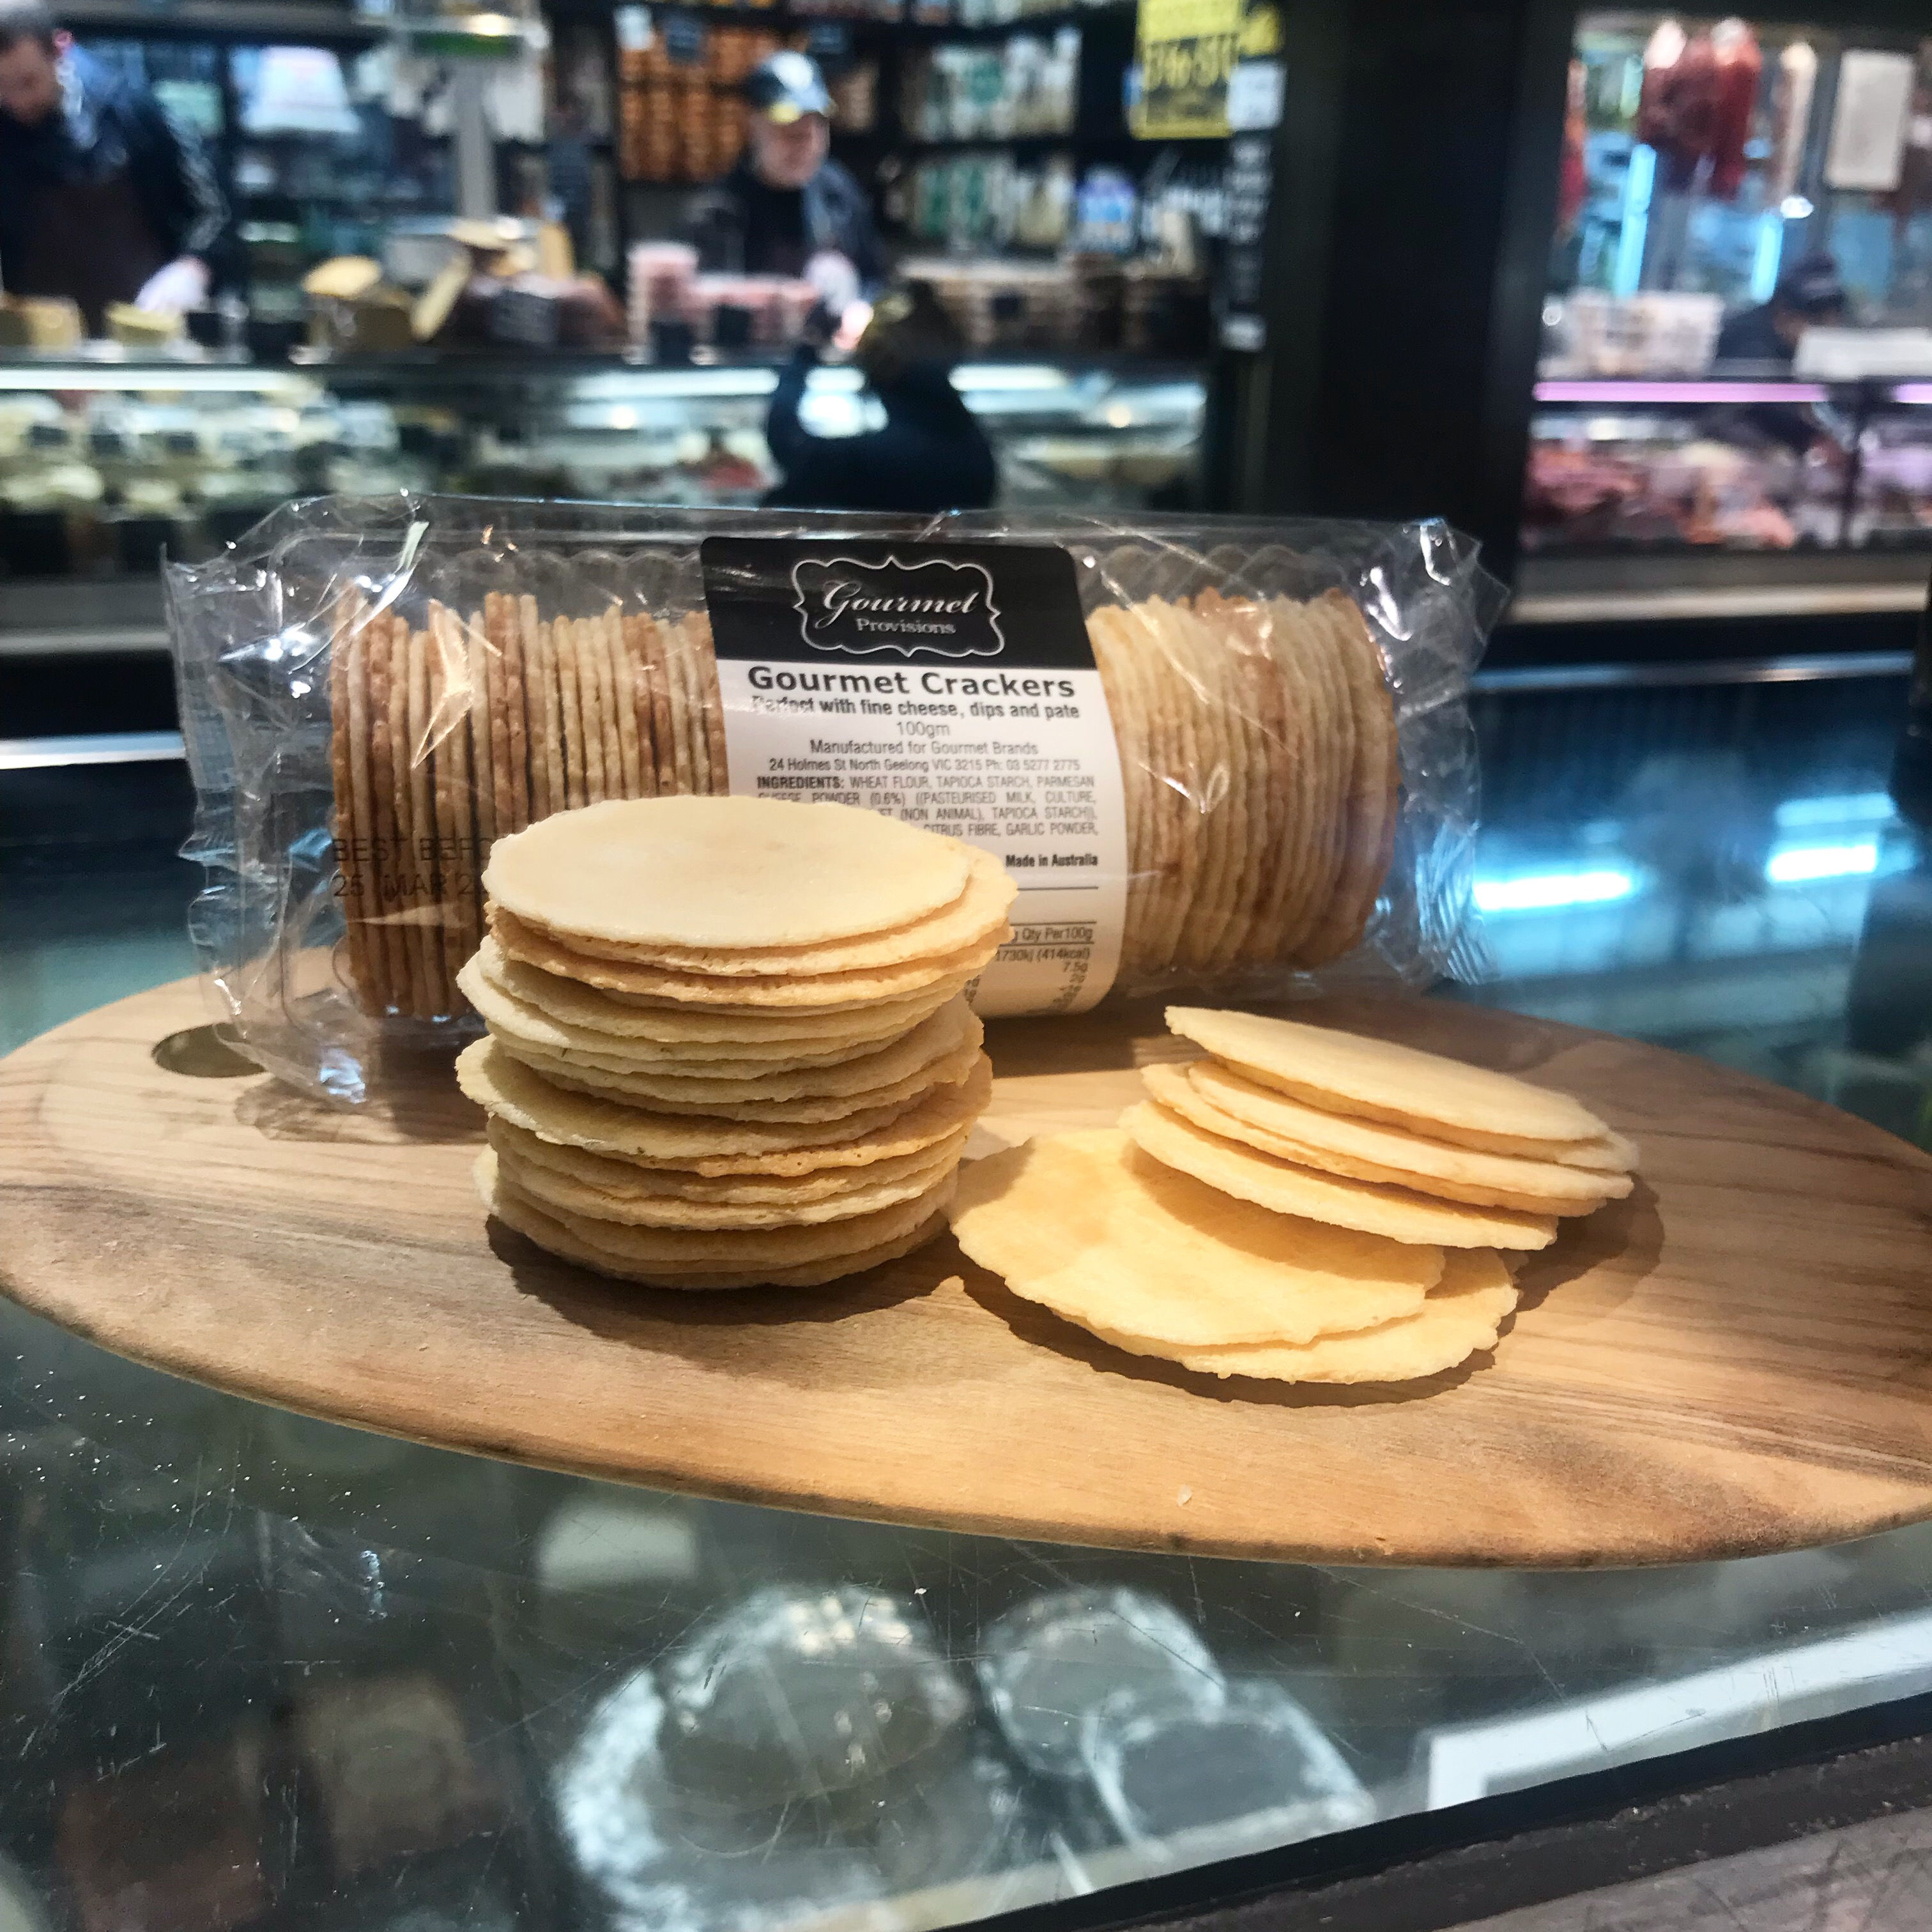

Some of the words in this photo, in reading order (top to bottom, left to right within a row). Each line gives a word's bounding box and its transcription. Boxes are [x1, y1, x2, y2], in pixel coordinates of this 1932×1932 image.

[815, 580, 979, 629] Gourmet
[855, 618, 956, 634] Provisions
[747, 666, 910, 694] Gourmet
[921, 671, 1075, 698] Crackers
[819, 698, 857, 714] with
[860, 699, 893, 715] fine
[898, 700, 965, 719] cheese,
[969, 702, 1005, 720] dips
[1009, 703, 1039, 717] and
[1045, 705, 1080, 721] pate
[896, 721, 950, 739] 100gm
[809, 739, 903, 754] Manufactured
[908, 740, 926, 754] for
[931, 741, 988, 755] Gourmet
[992, 742, 1039, 755] Brands
[769, 758, 784, 770] 24
[787, 758, 831, 770] Holmes
[834, 758, 846, 770] St
[849, 758, 882, 770] North
[884, 759, 929, 772] Geelong
[931, 759, 951, 770] VIC
[954, 759, 982, 770] 3215
[1006, 759, 1021, 770] 03
[1023, 759, 1049, 770] 5277
[1054, 759, 1081, 770] 2775
[756, 776, 845, 789] INGREDIENTS:
[848, 776, 888, 789] WHEAT
[893, 776, 932, 789] FLOUR,
[936, 775, 983, 788] TAPIOCA
[1036, 775, 1094, 788] PARMESAN
[812, 792, 860, 805] POWDER
[1045, 790, 1096, 804] CULTURE,
[900, 808, 929, 821] (NON
[992, 807, 1038, 820] TAPIOCA
[1006, 823, 1045, 836] GARLIC
[1050, 822, 1098, 836] POWDER,
[333, 838, 408, 861] BEST
[1006, 854, 1036, 868] Made
[1038, 854, 1048, 867] in
[1051, 853, 1098, 867] Australia
[333, 873, 364, 897] 25
[1022, 928, 1041, 941] Qty
